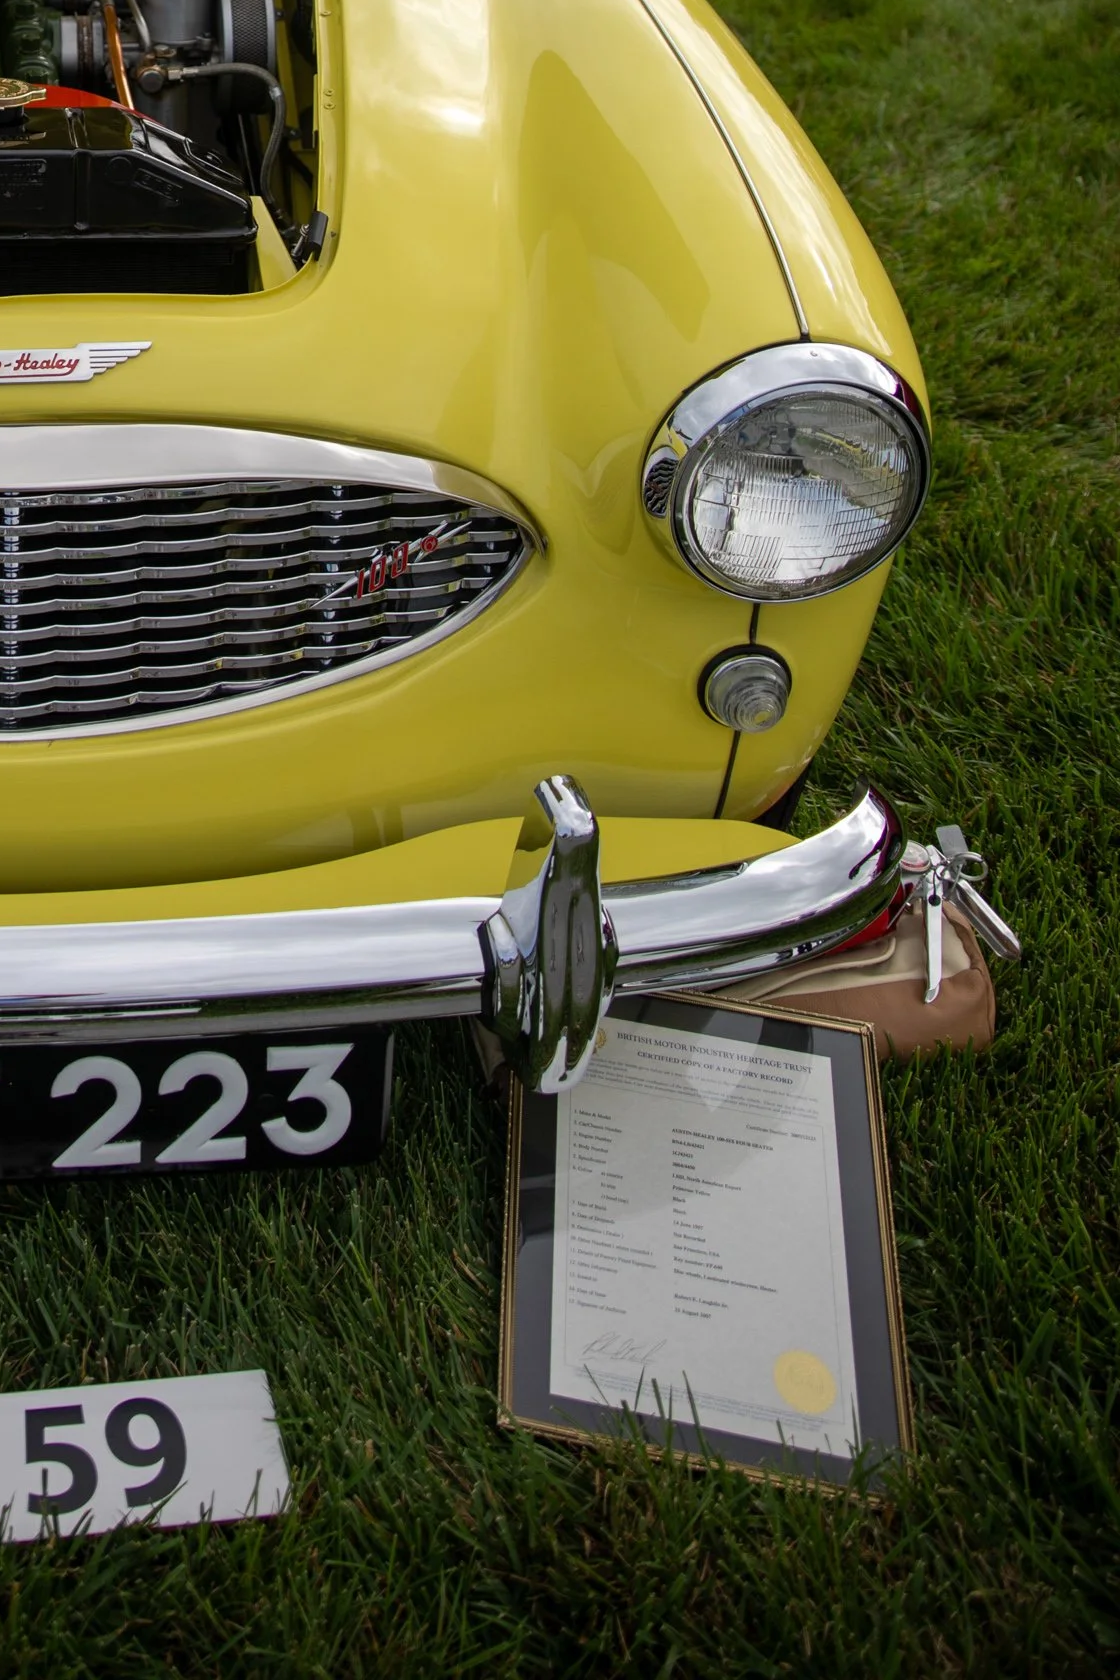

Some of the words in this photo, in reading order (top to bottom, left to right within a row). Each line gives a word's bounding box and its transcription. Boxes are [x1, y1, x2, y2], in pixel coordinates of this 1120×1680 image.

[616, 1032, 653, 1045] BRITISH
[653, 1039, 688, 1051] MOTOR
[690, 1045, 735, 1061] INDUSTRY
[736, 1053, 782, 1068] HERITAGE
[782, 1061, 814, 1074] TRUST
[637, 1051, 680, 1065] CERTIFIED
[681, 1059, 701, 1068] COPY
[722, 1067, 758, 1080] FACTORY
[760, 1072, 794, 1085] RECORD
[51, 1043, 355, 1168] 223
